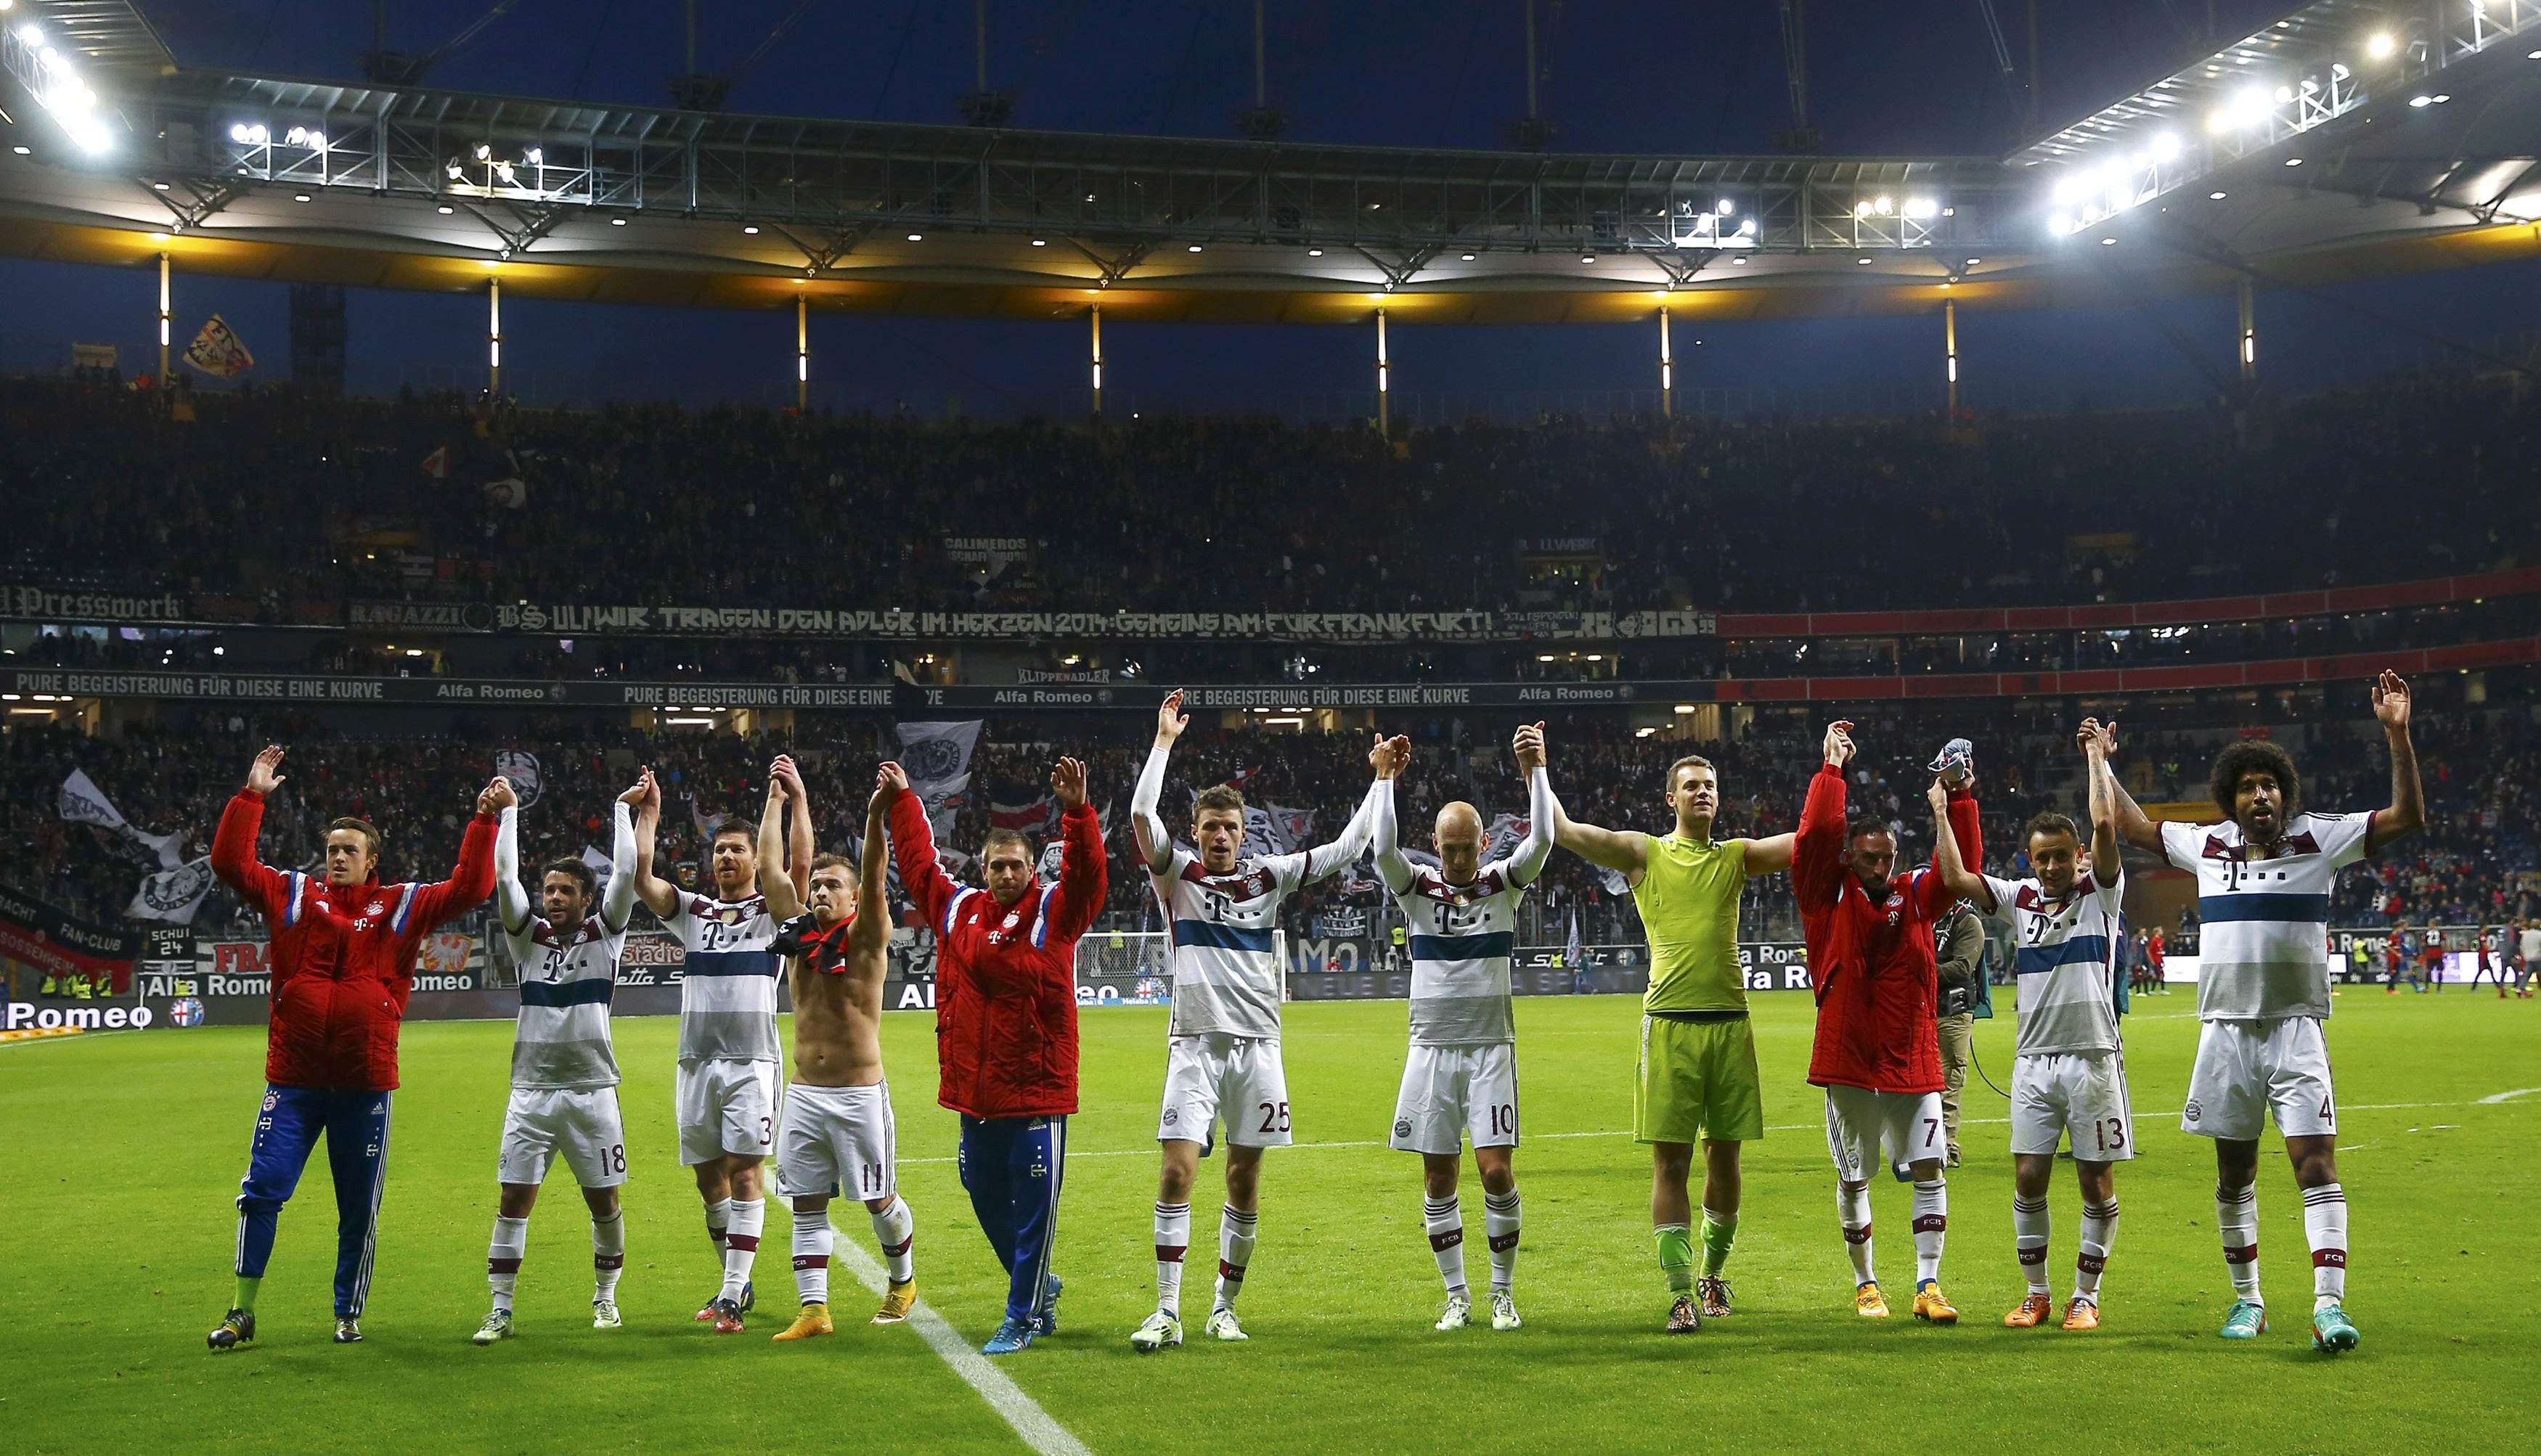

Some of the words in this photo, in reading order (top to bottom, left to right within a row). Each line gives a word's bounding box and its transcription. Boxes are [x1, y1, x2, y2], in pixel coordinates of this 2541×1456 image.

[16, 674, 62, 691] PURE
[68, 675, 196, 694] BEGEISTERUNG
[199, 676, 233, 695] FÜR
[236, 679, 282, 697] DIESE
[288, 681, 326, 698] EINE
[330, 682, 383, 699] KURVE
[1018, 668, 1110, 685] KLIPPENADLER
[437, 684, 473, 698] Alfa
[480, 685, 544, 699] Romeo
[624, 687, 663, 703] PURE
[668, 688, 778, 705] BEGEISTERUNG
[782, 687, 810, 705] FÜR
[815, 689, 856, 705] DIESE
[860, 689, 892, 705] EINE
[994, 690, 1029, 703] Alfa
[1034, 691, 1093, 703] Romeo
[1205, 690, 1308, 705] BEGEISTERUNG
[1313, 689, 1339, 705] FÜR
[1344, 690, 1382, 705] DIESE
[1388, 690, 1419, 704] EINE
[1423, 689, 1470, 704] KURVE
[1519, 689, 1551, 700] Alfa
[1557, 687, 1614, 700] Romeo
[60, 923, 123, 952] FAN-CLUB
[160, 941, 183, 955] 24
[208, 975, 272, 996] Rom
[409, 976, 473, 991] omeo
[898, 984, 936, 1008] Al
[7, 1002, 153, 1029] Romeo
[1259, 1102, 1292, 1133] 25
[1490, 1104, 1514, 1136] 10
[2319, 1095, 2333, 1126] 4
[759, 1116, 772, 1146] 3
[1923, 1118, 1938, 1148] 7
[2096, 1118, 2124, 1152] 13
[600, 1144, 626, 1177] 18
[864, 1163, 882, 1193] 11
[1442, 1234, 1459, 1244] FCB
[2084, 1260, 2102, 1269] FCB
[2325, 1251, 2344, 1261] FCB
